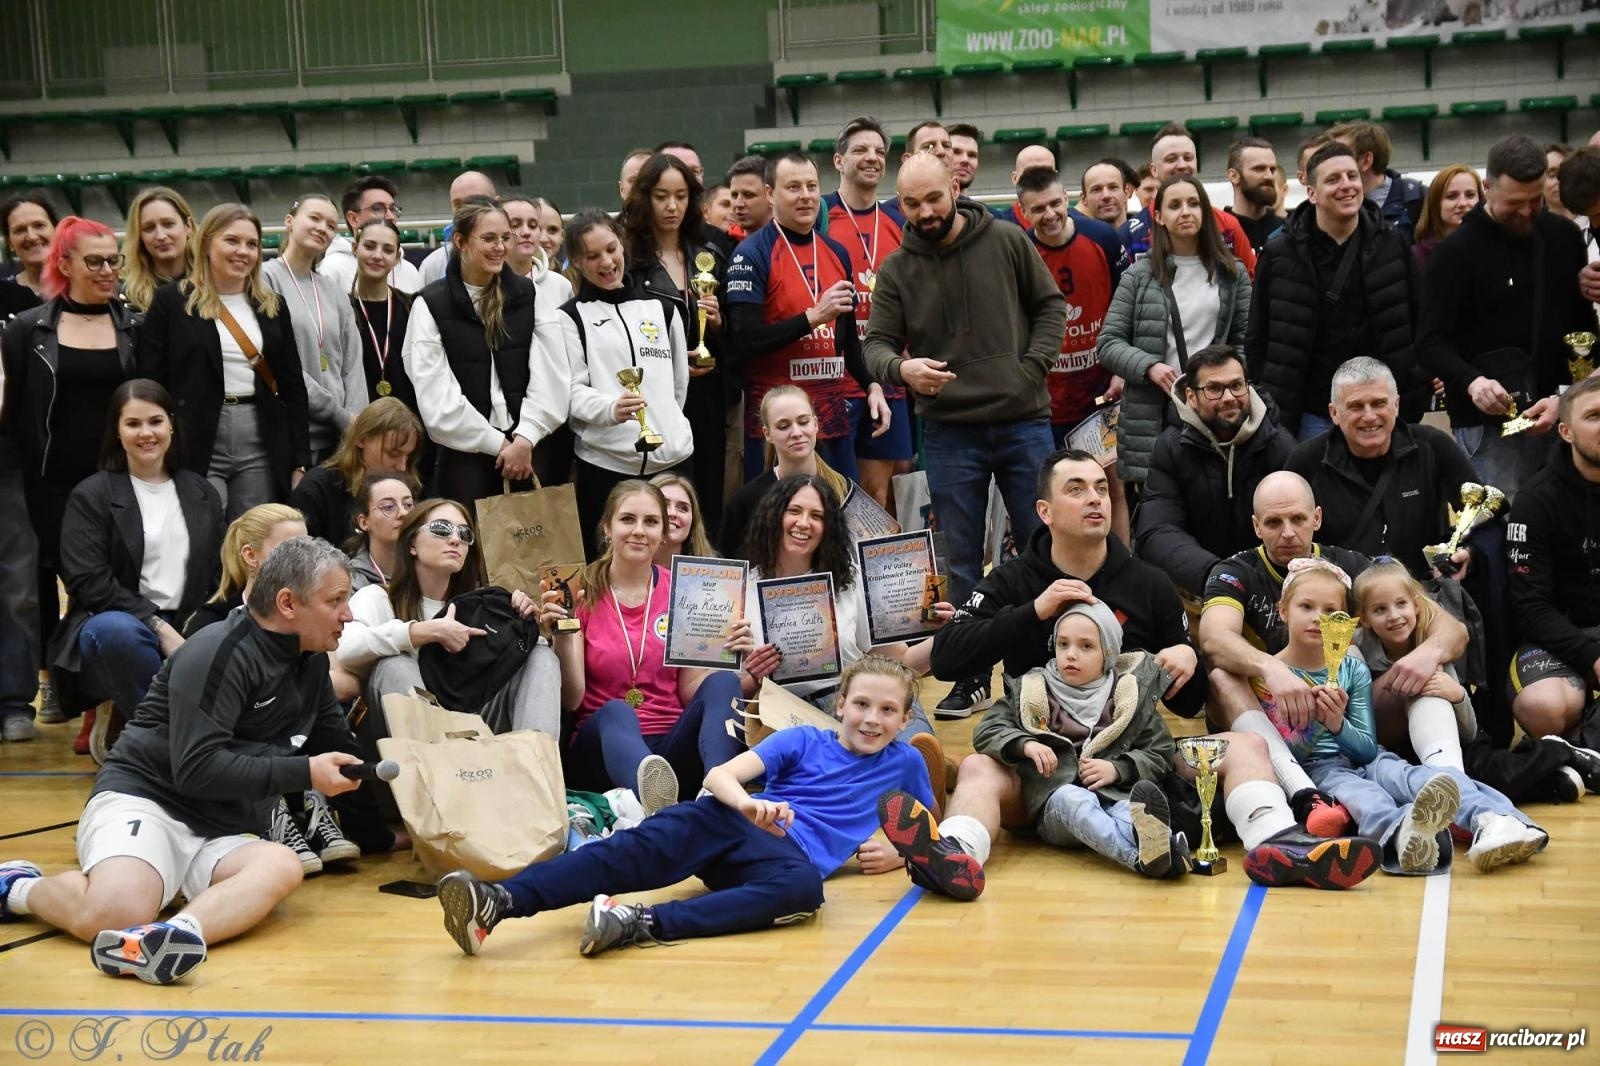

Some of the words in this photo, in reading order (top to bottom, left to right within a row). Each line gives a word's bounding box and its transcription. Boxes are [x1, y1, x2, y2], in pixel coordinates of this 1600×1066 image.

[1018, 3, 1049, 15] sklep
[966, 25, 1128, 53] WWW.ZOO-MAR.PL
[1057, 267, 1075, 295] 3
[680, 566, 740, 579] DYPLOM
[765, 583, 826, 599] DYPLOM
[127, 819, 141, 836] 1
